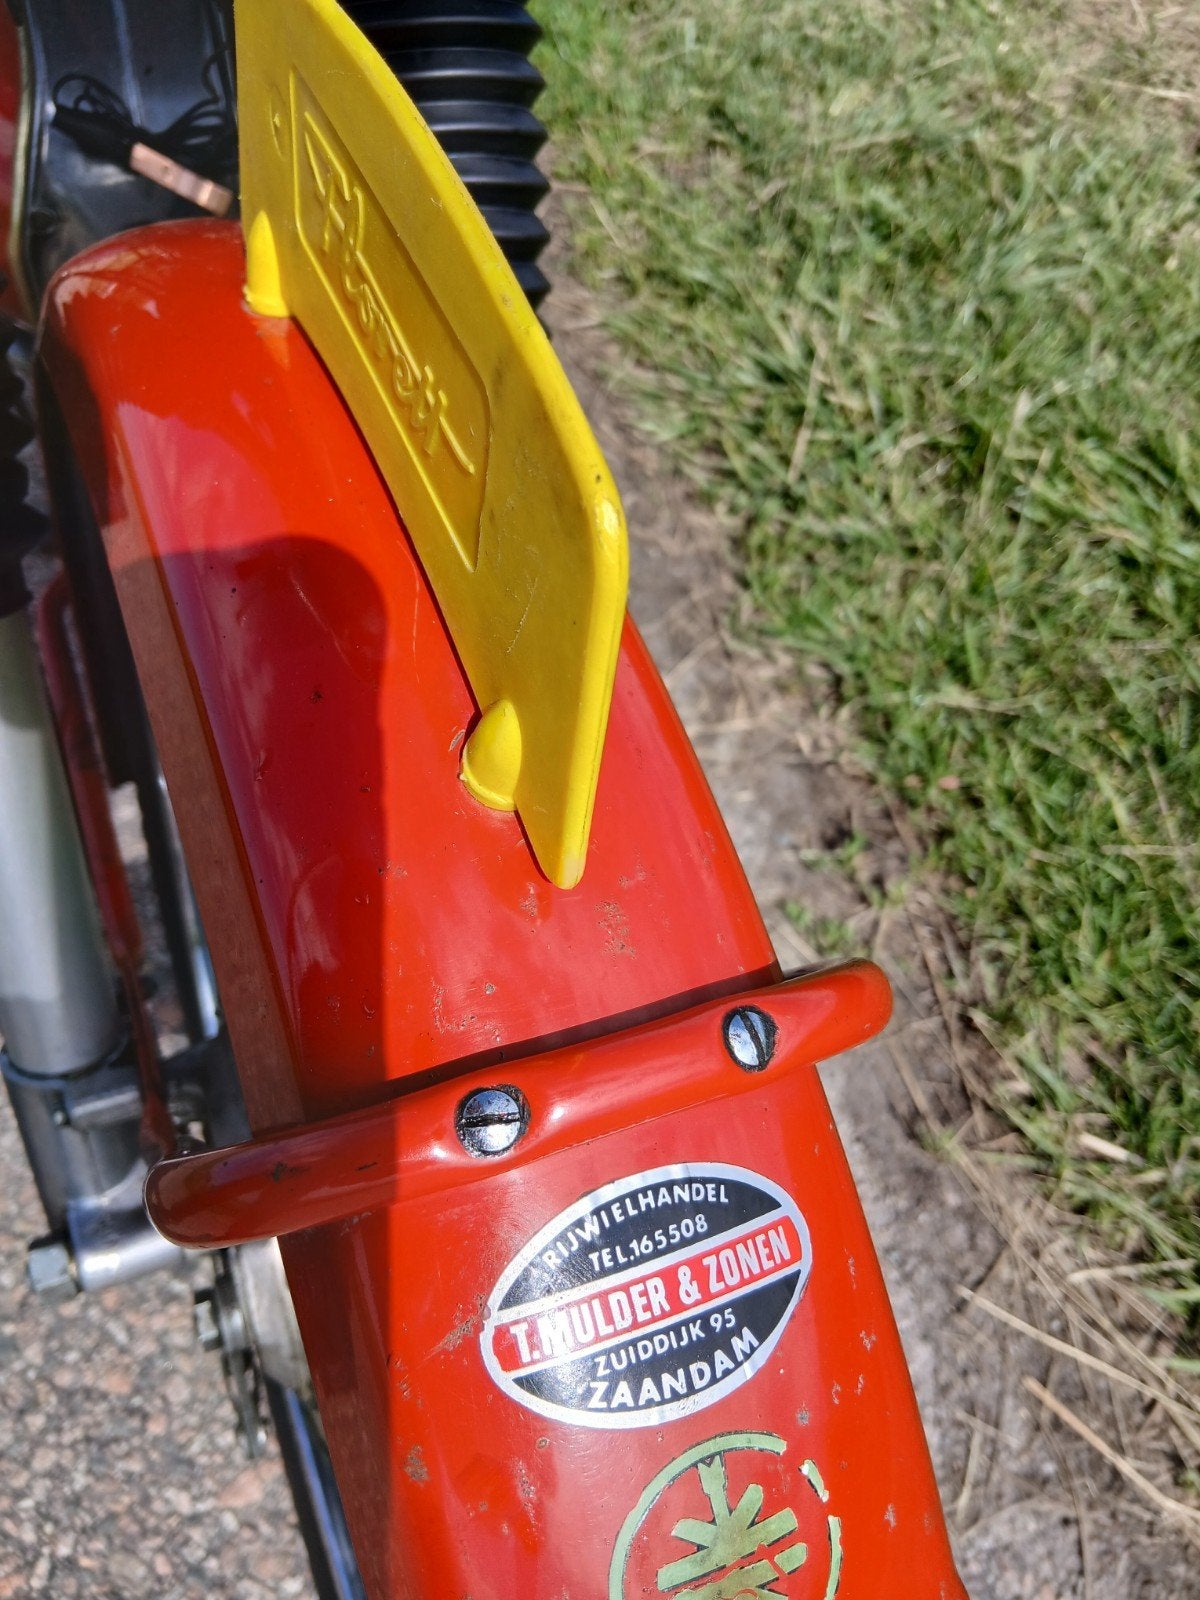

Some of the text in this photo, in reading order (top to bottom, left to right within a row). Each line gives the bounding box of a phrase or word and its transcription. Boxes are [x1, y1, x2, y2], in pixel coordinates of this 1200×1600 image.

[542, 1183, 729, 1269] RIJWIELHANDEL
[589, 1214, 709, 1272] TEL.165508
[510, 1225, 792, 1363] T.MULDER & ZONEN
[586, 1326, 760, 1409] ZAANDAM
[594, 1307, 737, 1378] ZUIDDIJK 95
